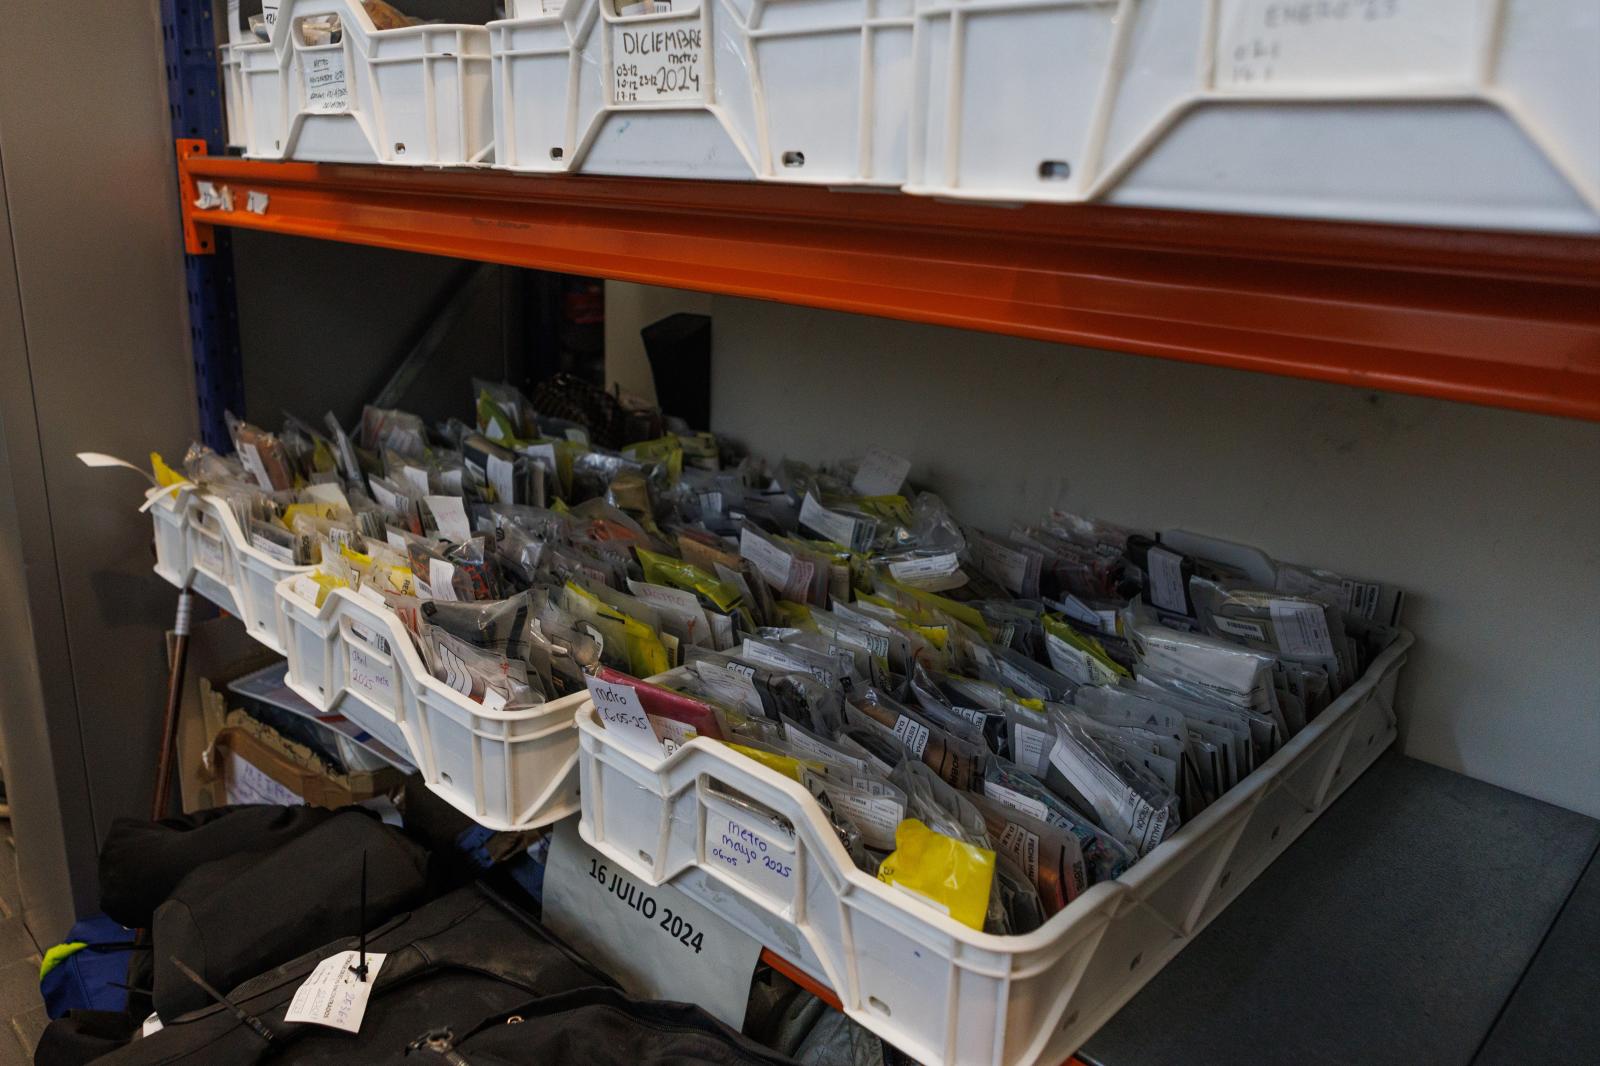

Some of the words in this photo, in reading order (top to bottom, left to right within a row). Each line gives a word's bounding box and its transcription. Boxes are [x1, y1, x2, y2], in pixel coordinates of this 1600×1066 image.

[623, 29, 702, 55] DICIEMBRE
[668, 52, 698, 65] metro
[656, 65, 699, 94] 2024
[728, 820, 768, 853] metro
[722, 834, 757, 864] mayo
[762, 855, 792, 878] 2025
[588, 858, 608, 885] 16
[608, 873, 657, 919] JULIO
[659, 908, 704, 954] 2024
